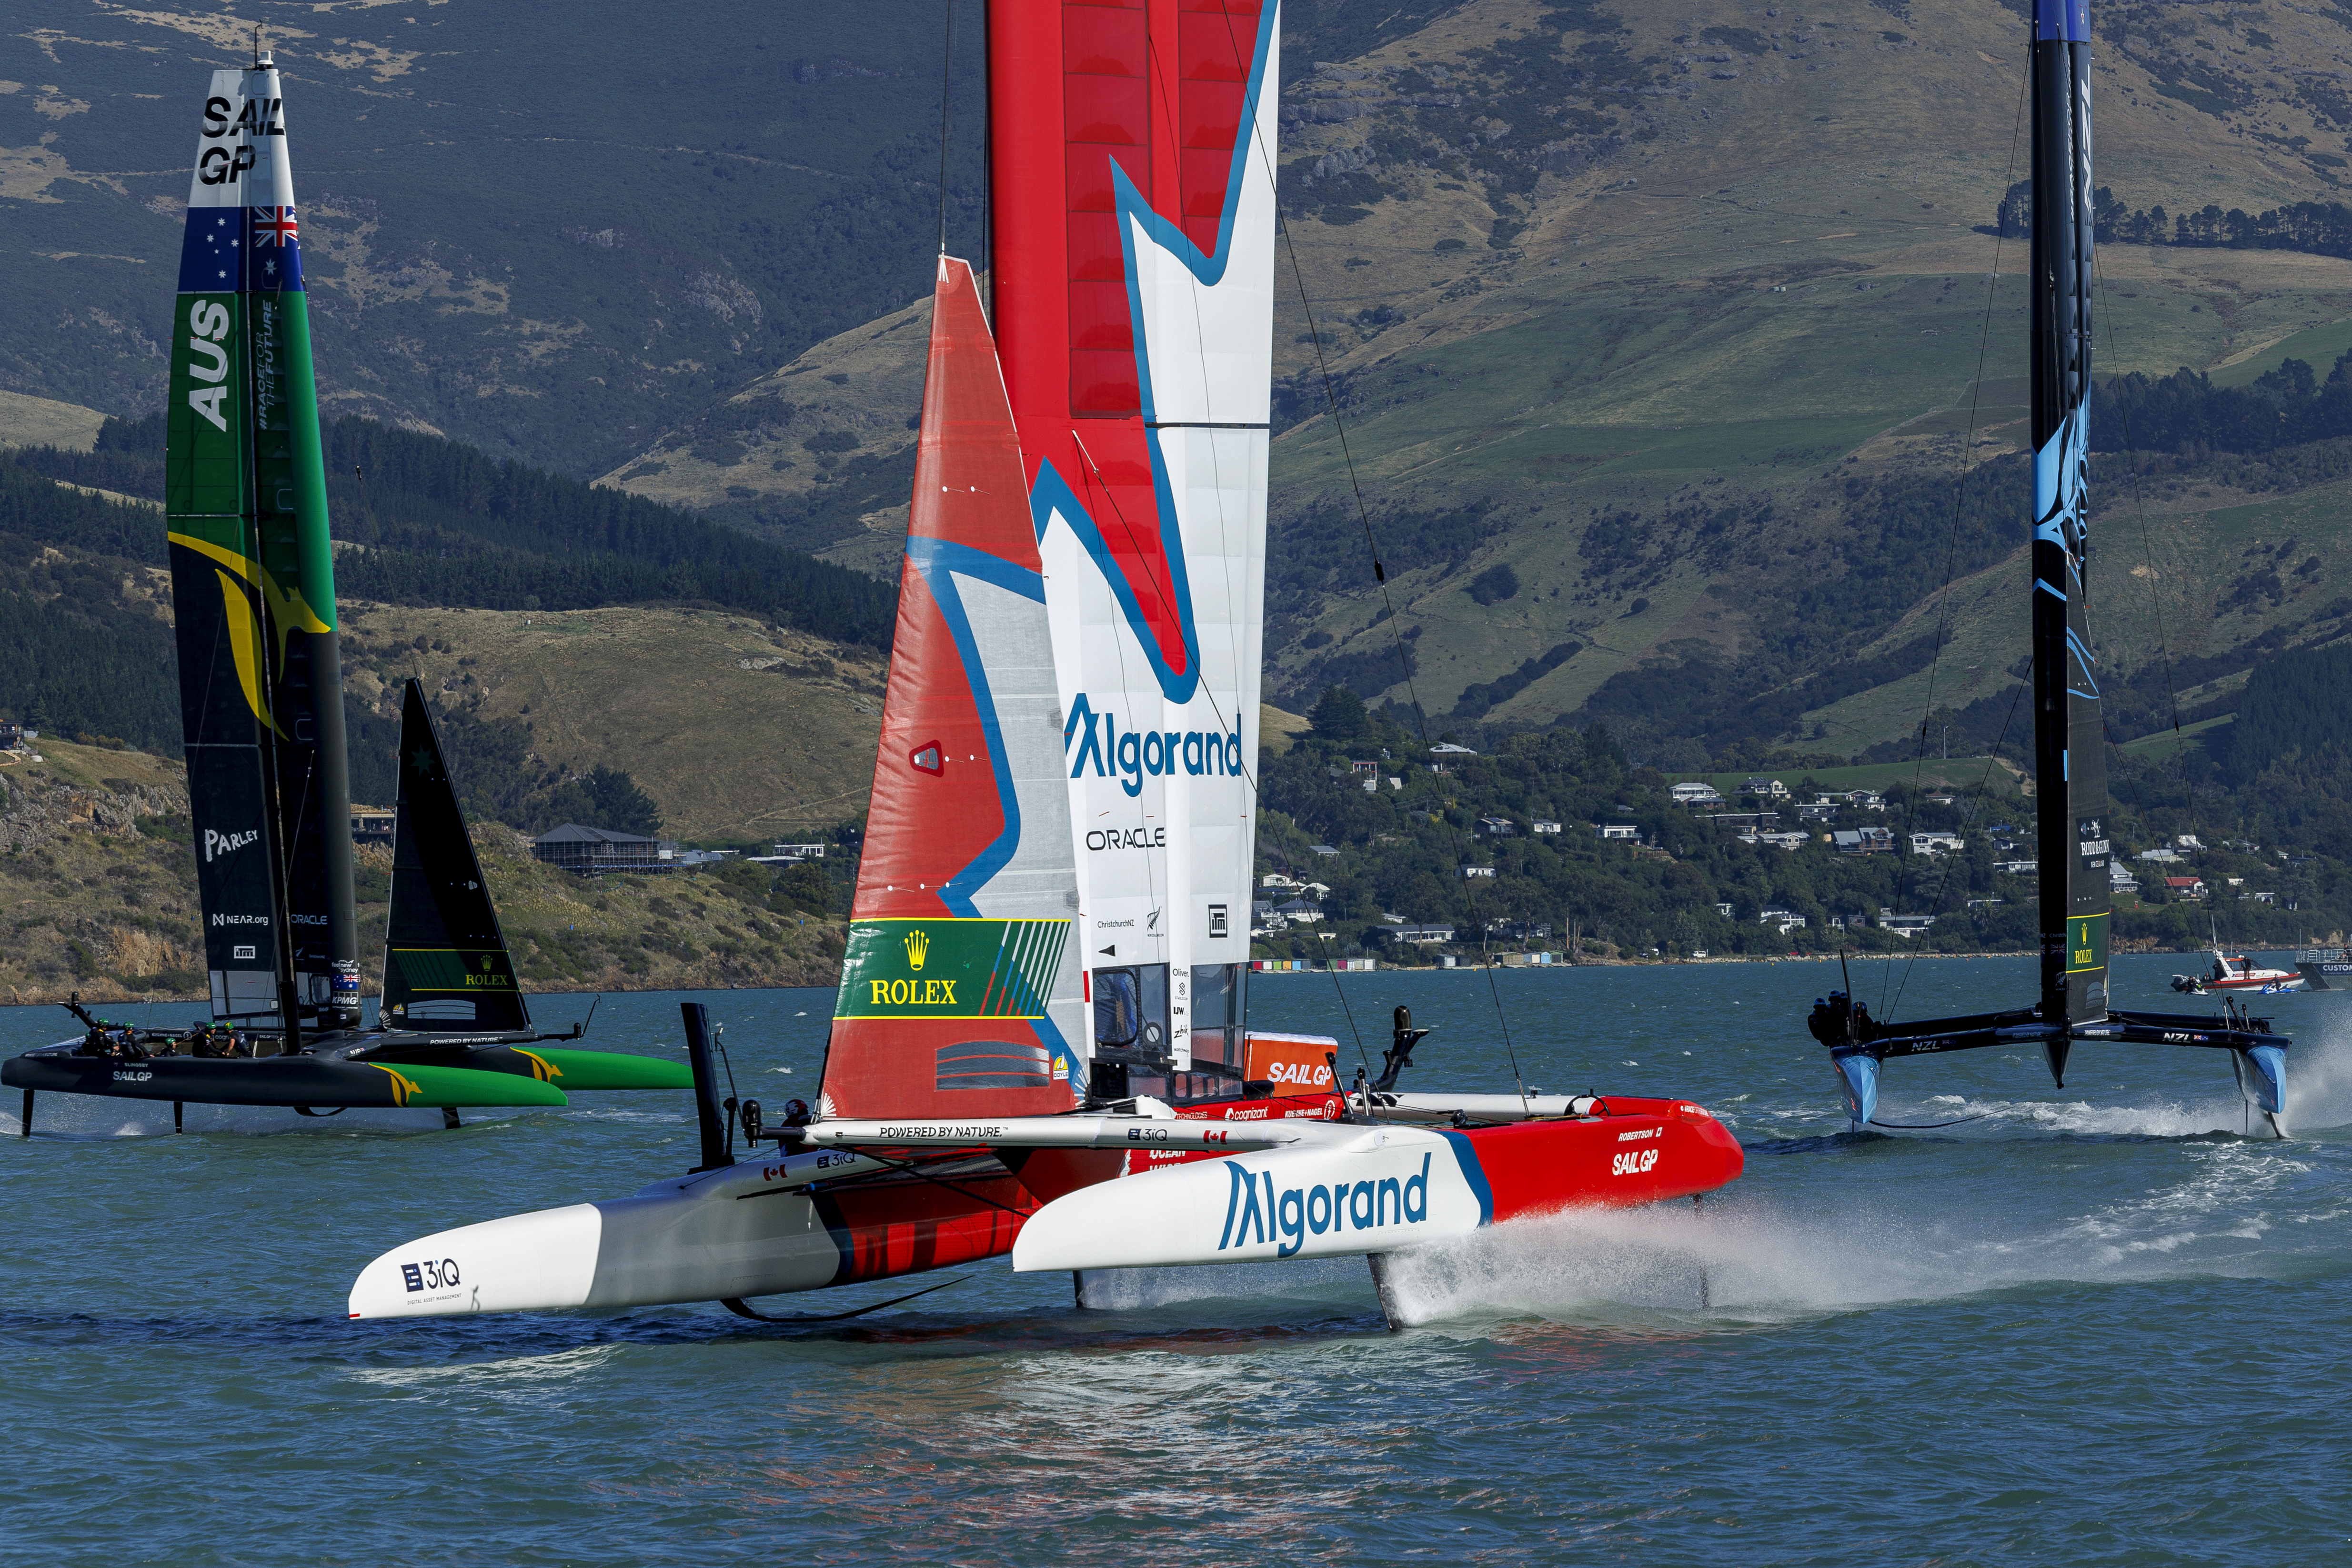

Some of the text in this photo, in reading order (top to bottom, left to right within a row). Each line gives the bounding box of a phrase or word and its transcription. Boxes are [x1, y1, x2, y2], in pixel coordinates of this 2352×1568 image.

[201, 97, 285, 138] SAIL
[2081, 63, 2091, 213] NZL
[198, 145, 256, 186] GP
[189, 300, 230, 432] AUS
[1064, 693, 1242, 797] Algorand
[205, 829, 258, 862] PARLEY
[1086, 827, 1166, 851] ORACLE
[226, 915, 268, 925] NEAR.org
[290, 914, 327, 925] ORACLE
[1097, 919, 1135, 928] ChristchurchNZ
[2075, 949, 2092, 964] ROLEX
[1173, 968, 1189, 977] Oliver.
[465, 975, 508, 985] ROLEX
[870, 979, 957, 1005] ROLEX
[332, 996, 357, 1005] KPMG
[2162, 1032, 2191, 1043] NZL
[1911, 1040, 1940, 1052] NZL
[1234, 1106, 1269, 1121] cognizant
[1285, 1108, 1323, 1118] KUEHNE+NAGEL
[879, 1126, 936, 1138] POWERED
[937, 1127, 953, 1137] BY
[1618, 1129, 1654, 1142] ROBERTSON
[1217, 1152, 1432, 1258] Algorand
